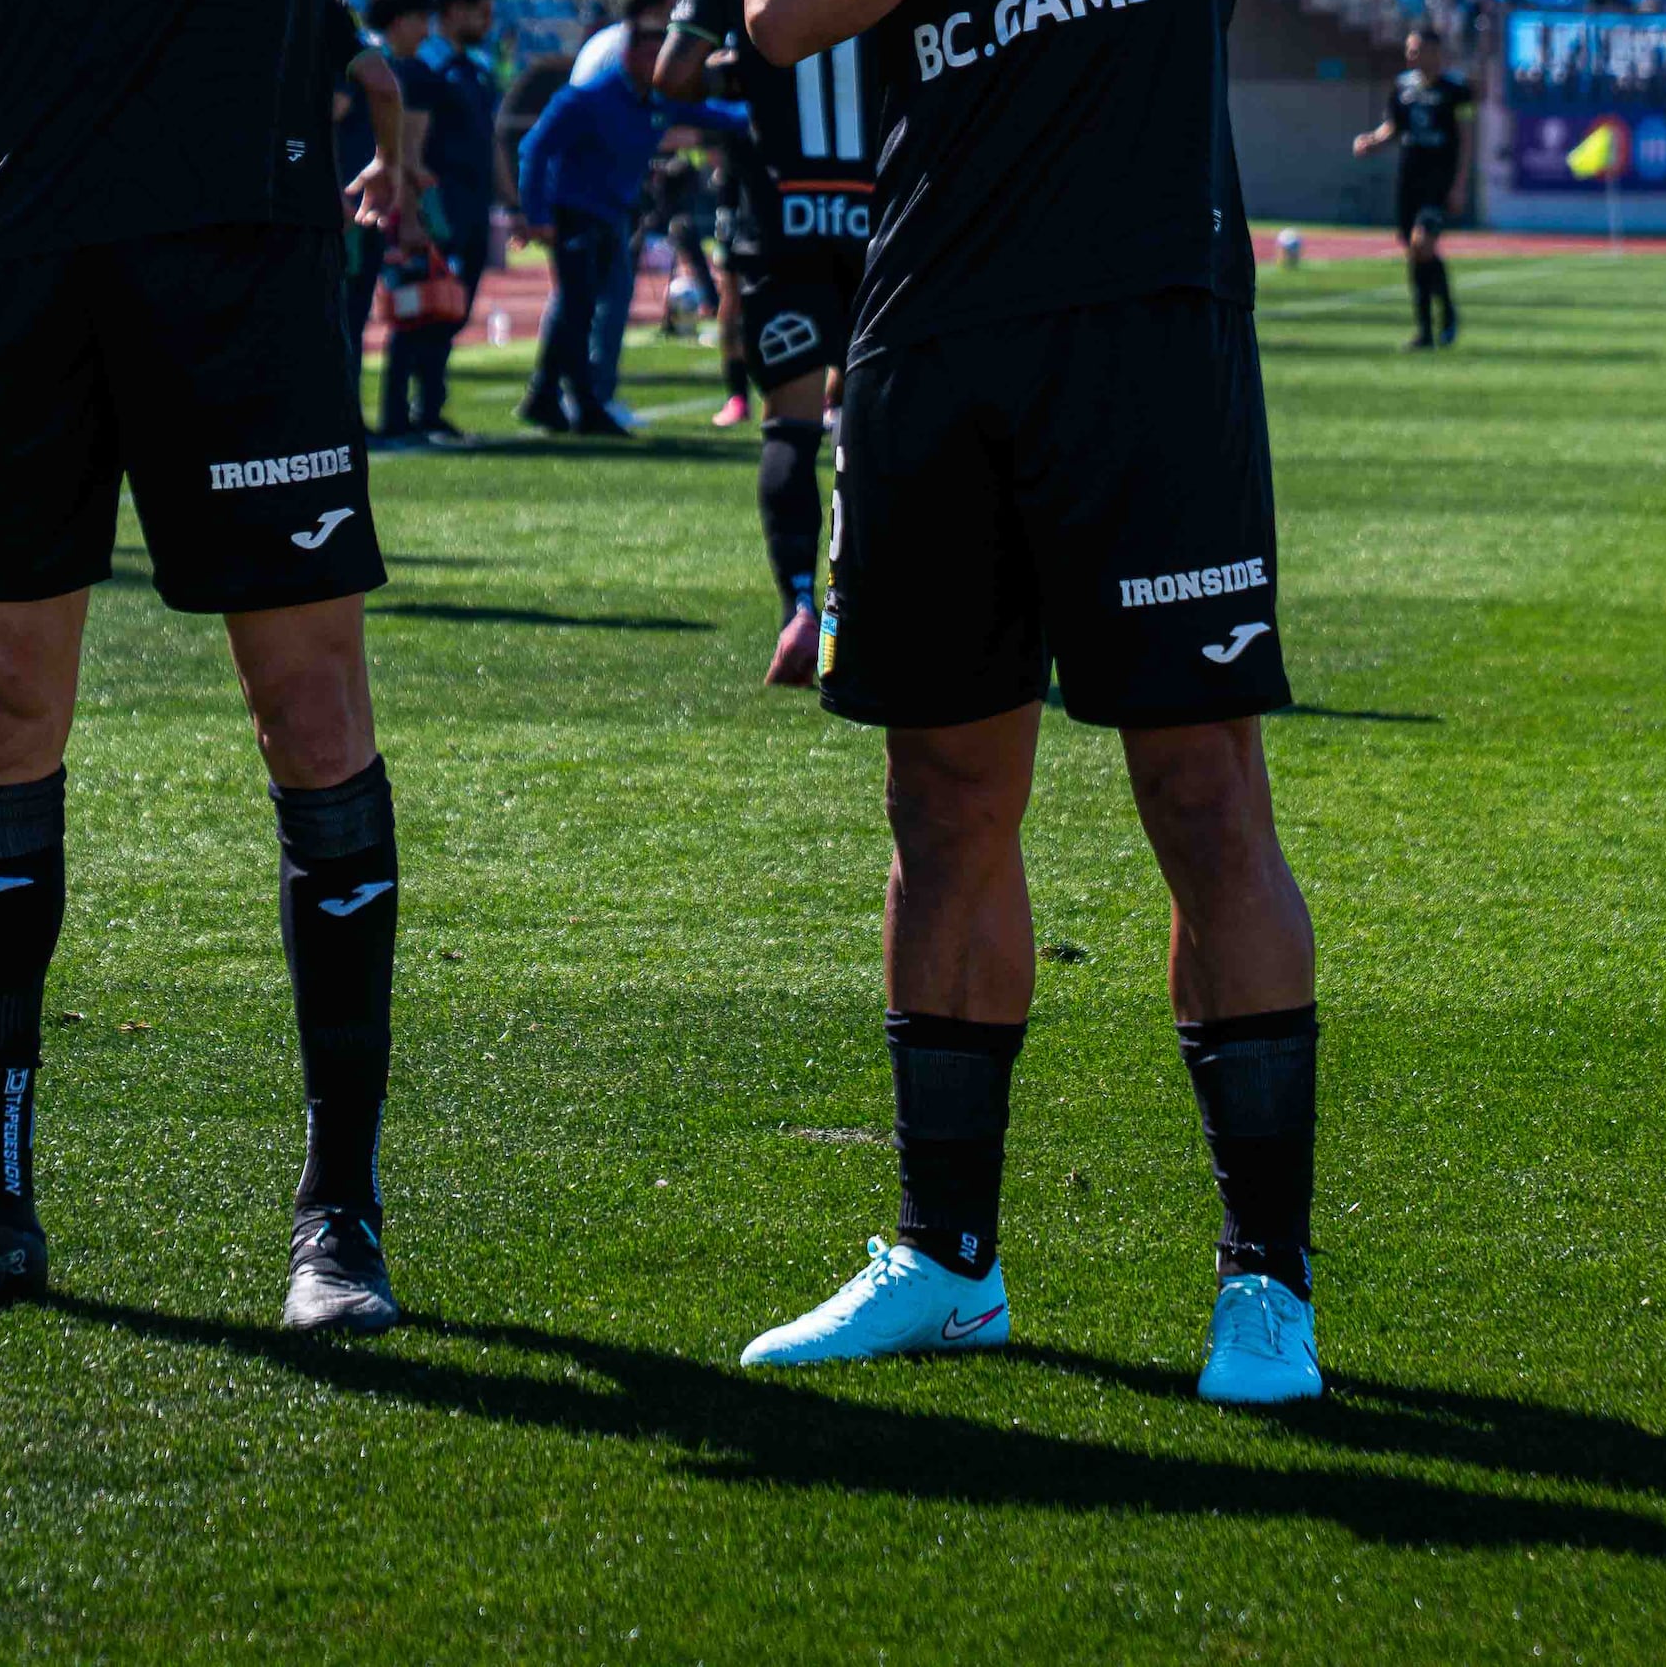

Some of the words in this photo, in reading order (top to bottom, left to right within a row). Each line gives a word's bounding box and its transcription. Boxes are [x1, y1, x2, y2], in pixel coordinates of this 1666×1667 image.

[795, 37, 864, 160] 11
[210, 445, 352, 490] IRONSIDE
[1119, 557, 1267, 608] IRONSIDE
[3, 1093, 22, 1196] TAPEDESIGN
